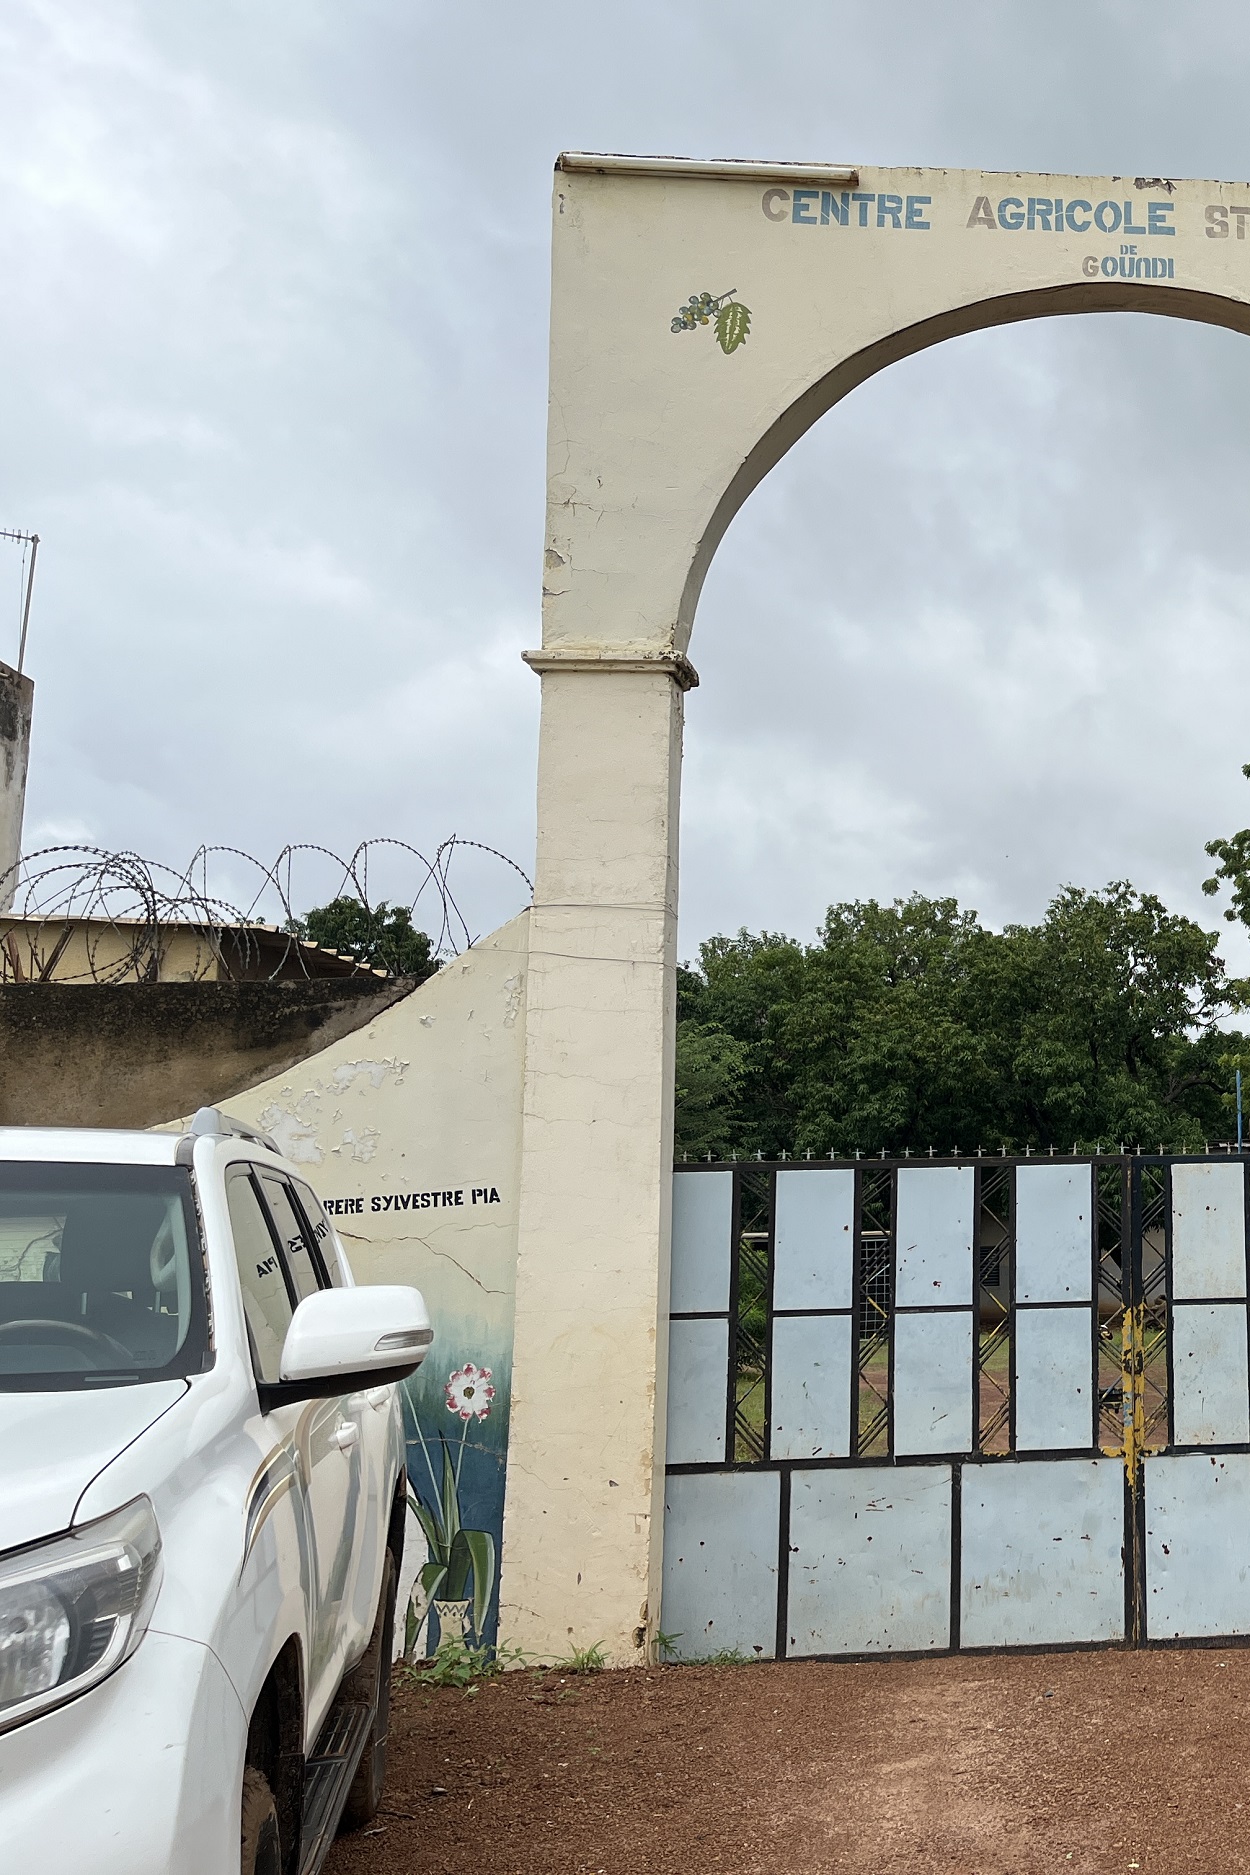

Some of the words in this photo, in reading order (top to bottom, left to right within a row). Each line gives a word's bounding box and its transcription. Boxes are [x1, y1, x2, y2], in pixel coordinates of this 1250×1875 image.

[761, 188, 932, 230] CENTRE
[966, 195, 1176, 236] AGRICOLE
[1120, 244, 1138, 256] DE
[1082, 256, 1175, 279] GOUNDI
[322, 1198, 365, 1215] RERE
[371, 1190, 464, 1212] SYLVESTRE
[471, 1187, 501, 1204] PIA
